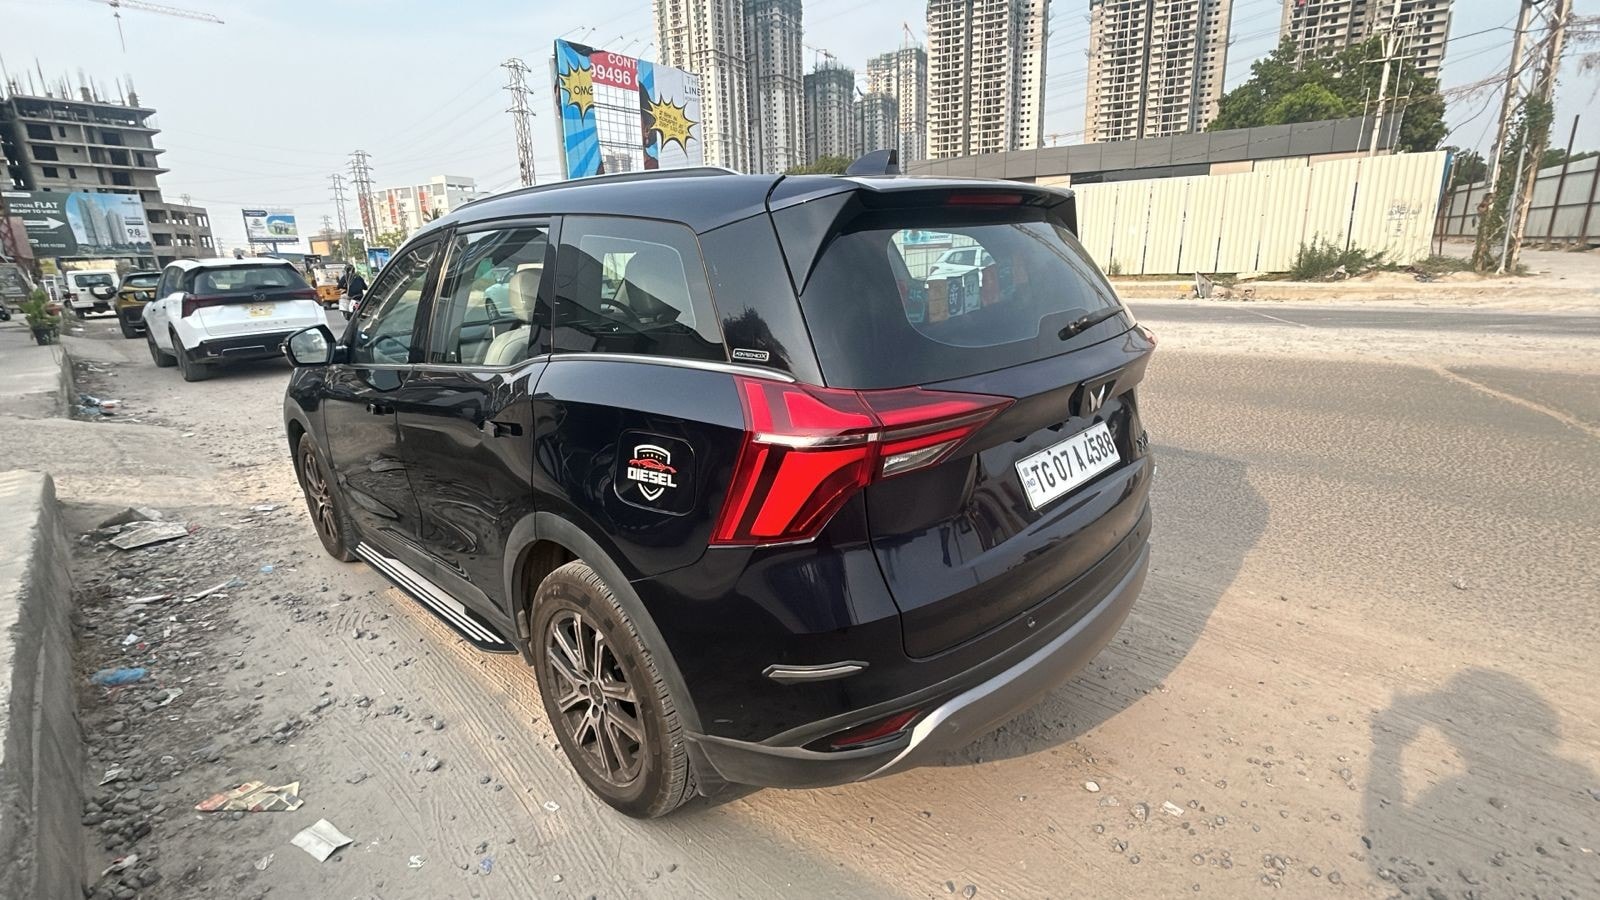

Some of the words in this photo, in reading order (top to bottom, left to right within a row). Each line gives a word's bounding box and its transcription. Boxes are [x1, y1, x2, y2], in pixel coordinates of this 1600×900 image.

[607, 53, 637, 69] CONT
[34, 201, 58, 209] FLAT
[1030, 461, 1056, 493] TG
[1053, 450, 1073, 481] 07
[1072, 445, 1087, 472] A
[1083, 431, 1115, 465] 4588
[627, 466, 678, 488] DIESEL
